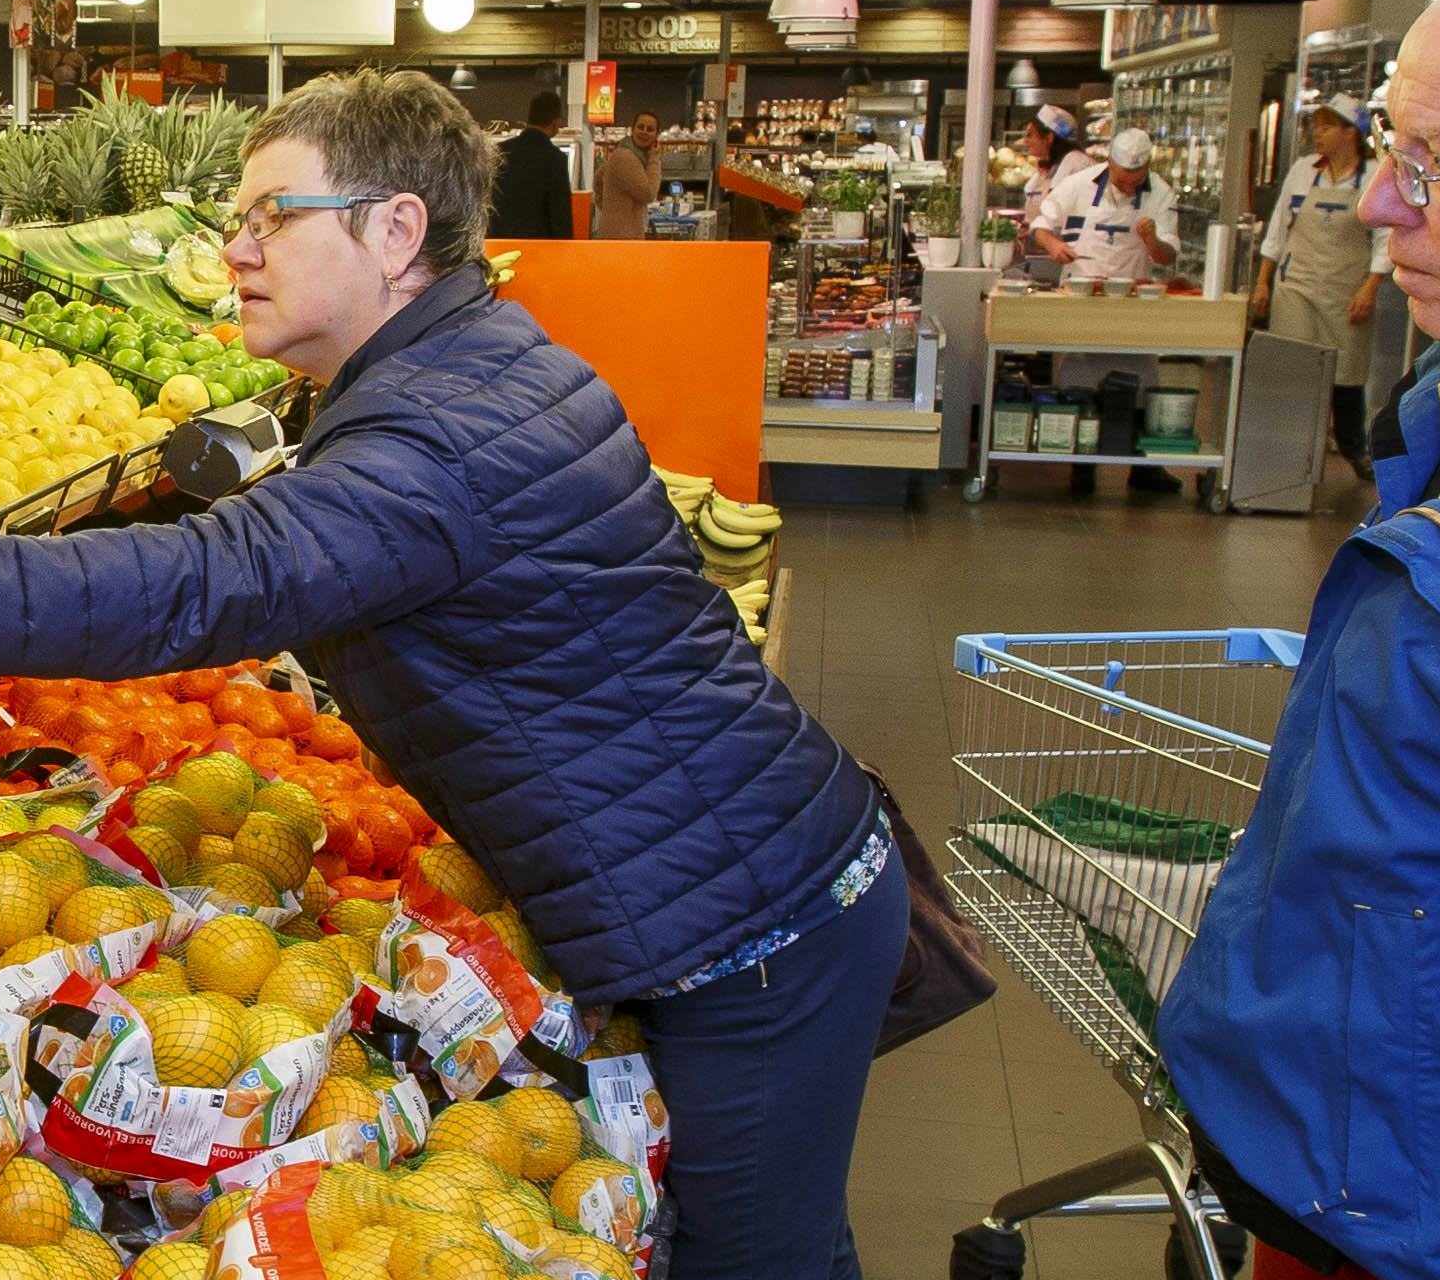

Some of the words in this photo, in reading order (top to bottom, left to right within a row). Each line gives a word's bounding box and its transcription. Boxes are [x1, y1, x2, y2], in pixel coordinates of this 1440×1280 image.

[600, 16, 698, 39] BROOD
[640, 41, 667, 51] vers
[94, 1086, 111, 1114] Pers-
